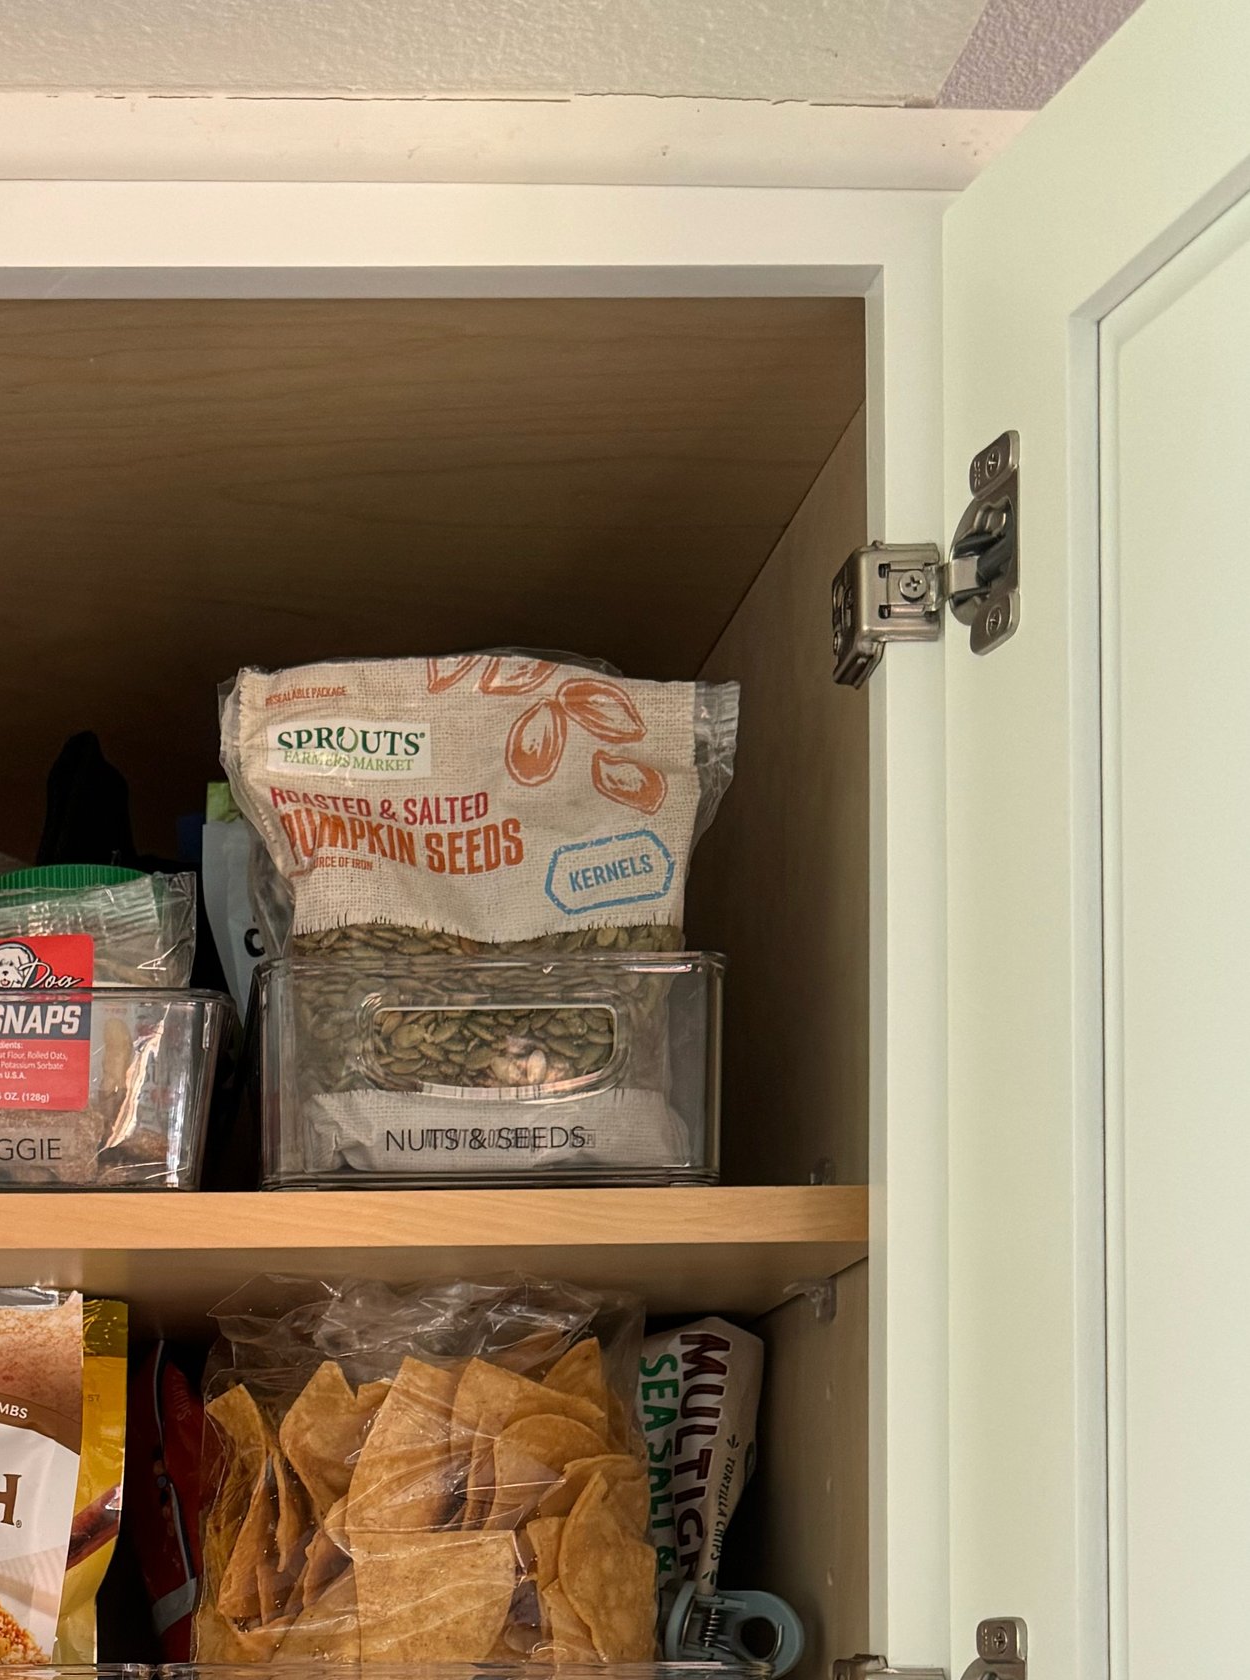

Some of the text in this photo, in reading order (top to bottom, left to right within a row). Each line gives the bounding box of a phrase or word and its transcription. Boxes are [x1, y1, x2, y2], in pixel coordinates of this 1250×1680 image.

[312, 686, 348, 698] PACKAGE
[283, 752, 415, 772] FARMERS MARKET
[270, 786, 489, 826] ROASTED & SALTED
[280, 807, 524, 875] PUMPKIN SEEDS
[338, 857, 374, 870] OF IRON
[568, 853, 655, 893] KERNELS
[1, 1061, 36, 1069] Potassium
[37, 1061, 64, 1070] Sorbate
[27, 1052, 49, 1060] Rolled
[50, 1052, 68, 1061] Oats,
[4, 1071, 27, 1079] U.S.A.
[4, 1092, 20, 1100] OZ.
[22, 1092, 50, 1103] (128g)
[386, 1128, 460, 1151] NUTS
[468, 1128, 488, 1150] &
[497, 1126, 586, 1150] SEEDS
[640, 1353, 680, 1529] SEA SALT
[710, 1457, 737, 1561] TORTILLA CHIPS
